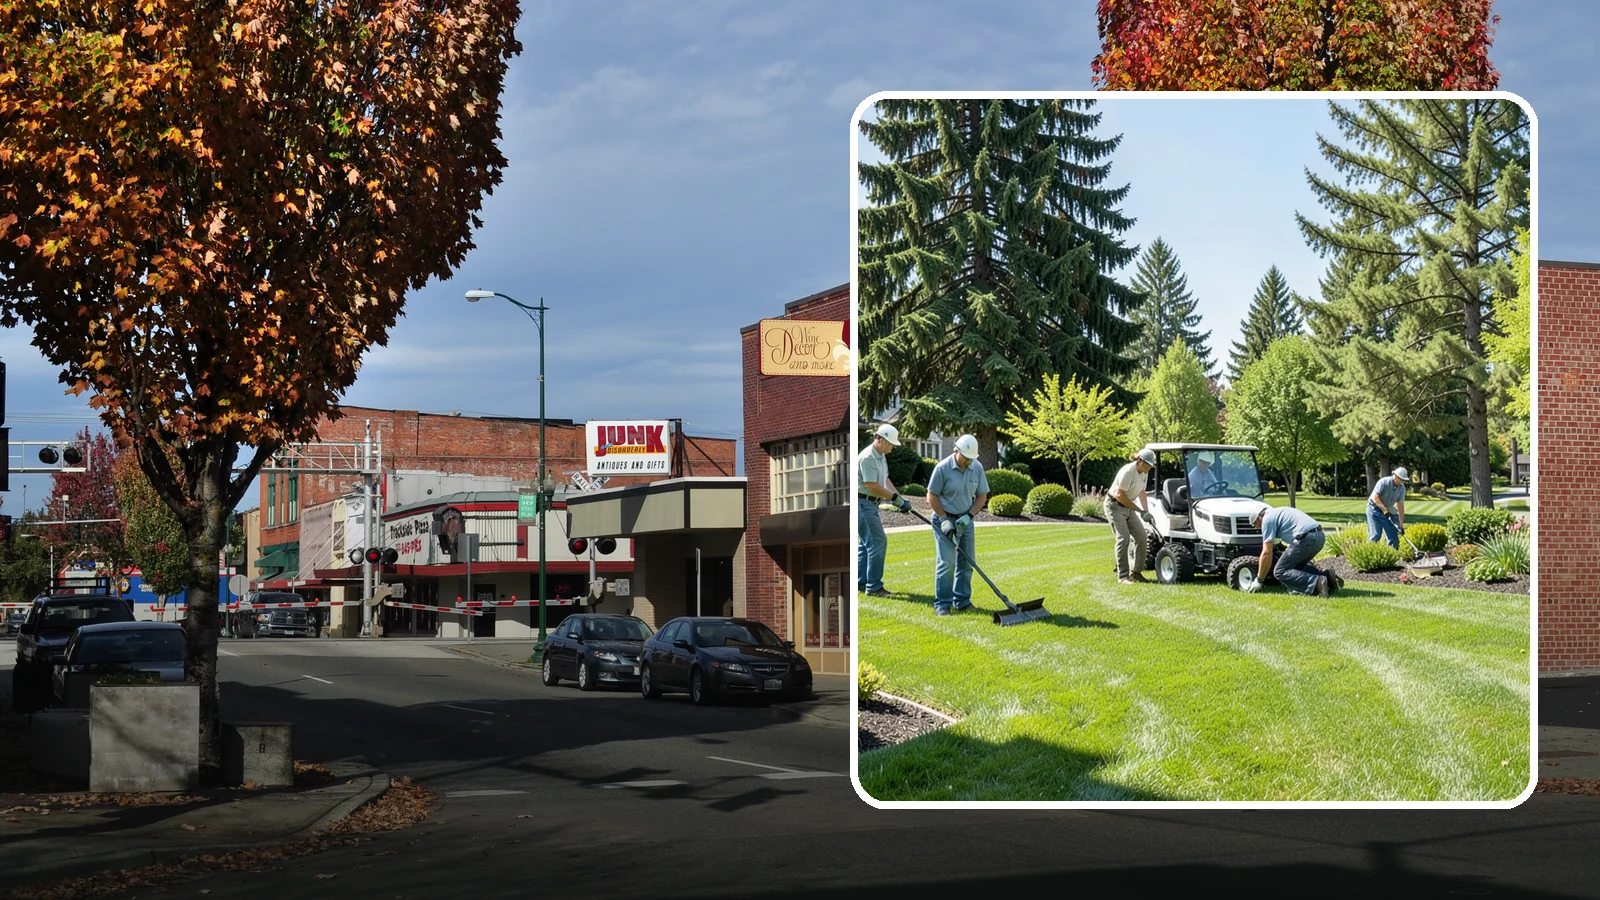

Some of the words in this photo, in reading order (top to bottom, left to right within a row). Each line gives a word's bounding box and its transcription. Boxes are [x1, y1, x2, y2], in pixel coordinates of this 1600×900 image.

[595, 425, 665, 457] JUNK
[607, 446, 646, 454] DISORDERLY
[597, 461, 628, 470] ANTIQUES
[631, 461, 644, 469] AND
[647, 460, 665, 469] GIFTS
[390, 521, 412, 539] Trackside
[415, 520, 429, 535] Pizza
